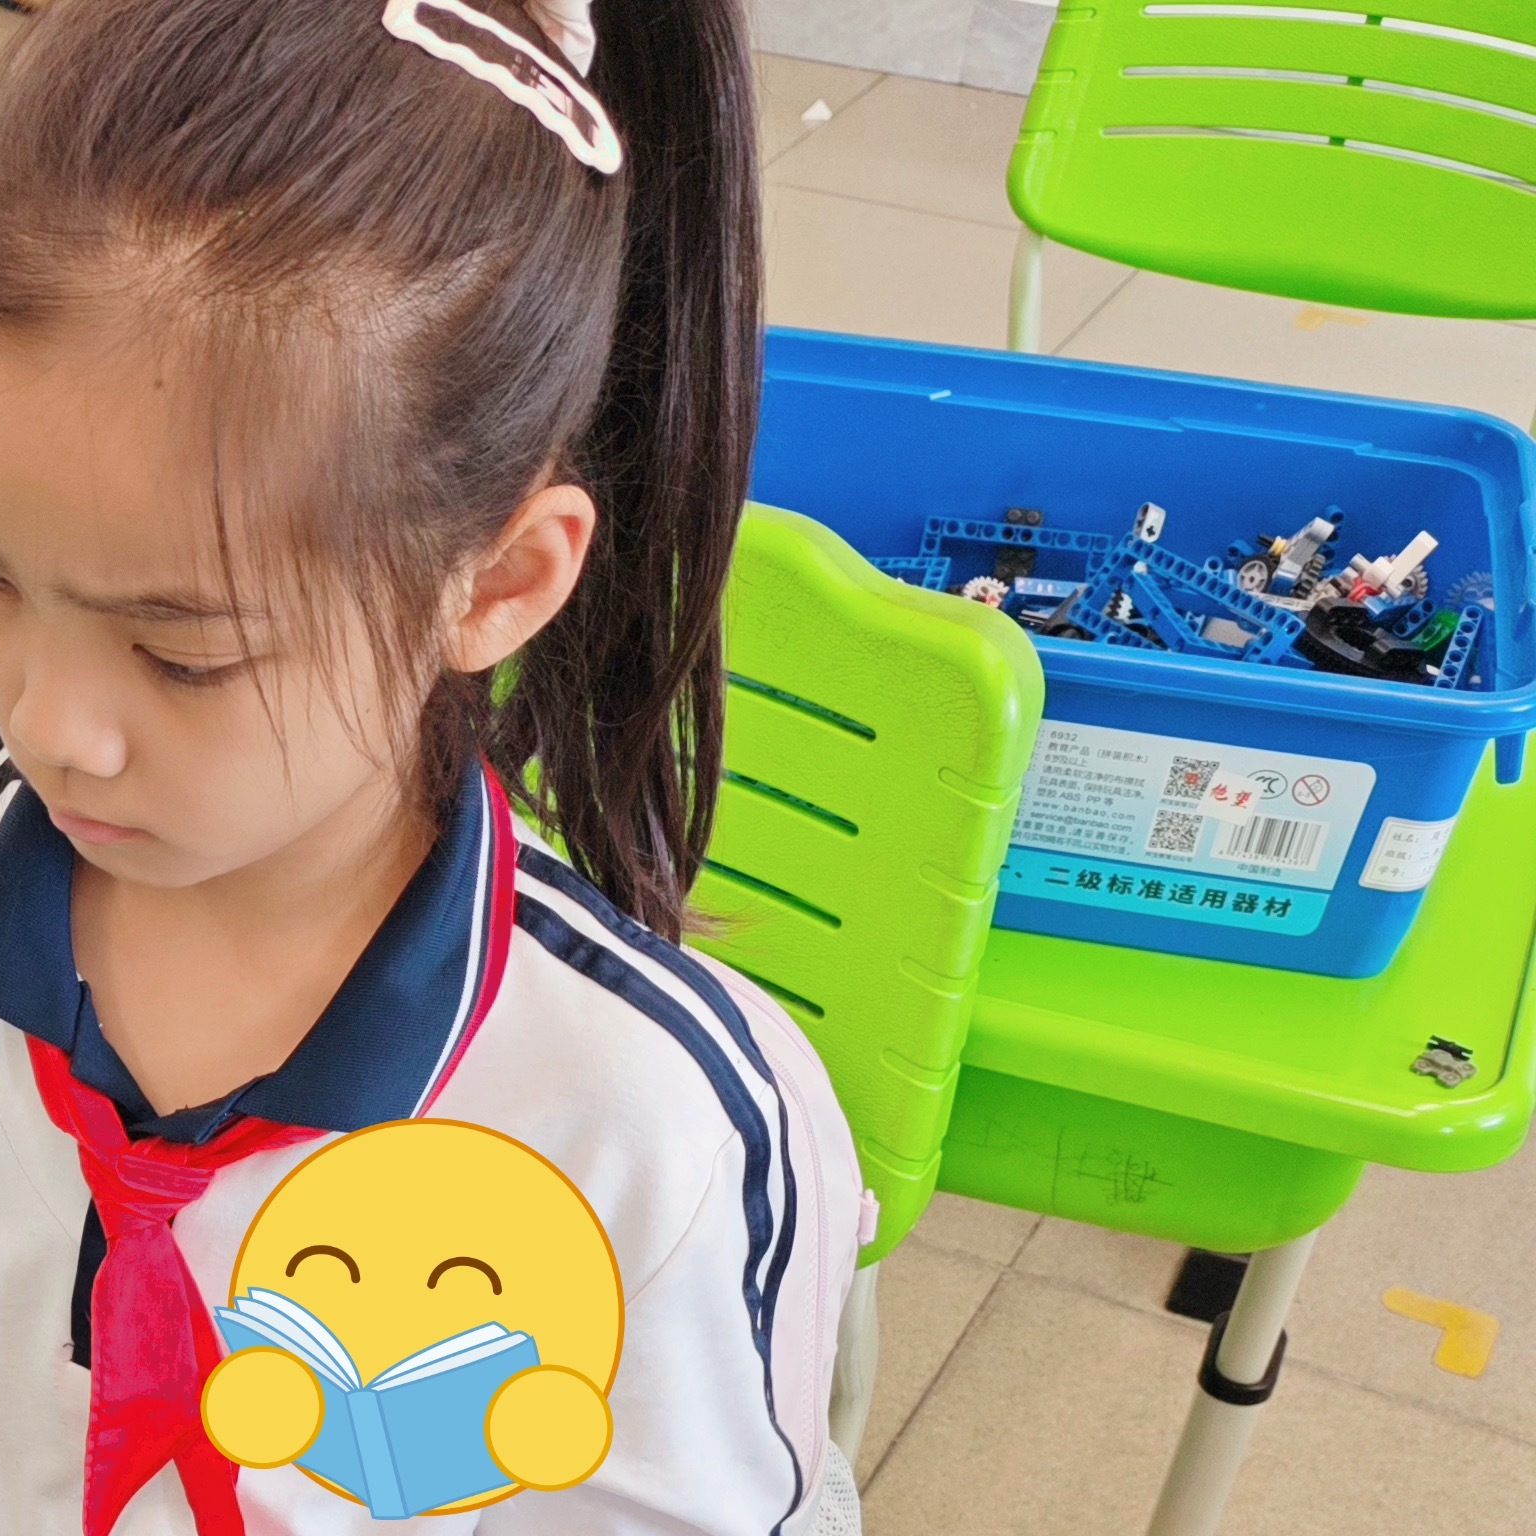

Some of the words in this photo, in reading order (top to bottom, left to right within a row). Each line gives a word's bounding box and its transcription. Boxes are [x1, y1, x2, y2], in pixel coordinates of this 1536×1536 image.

[1050, 730, 1078, 742] 6932
[1032, 800, 1136, 821] www.banbao.com
[1029, 811, 1133, 833] service@banbao.com
[1237, 863, 1281, 877] 中国制造
